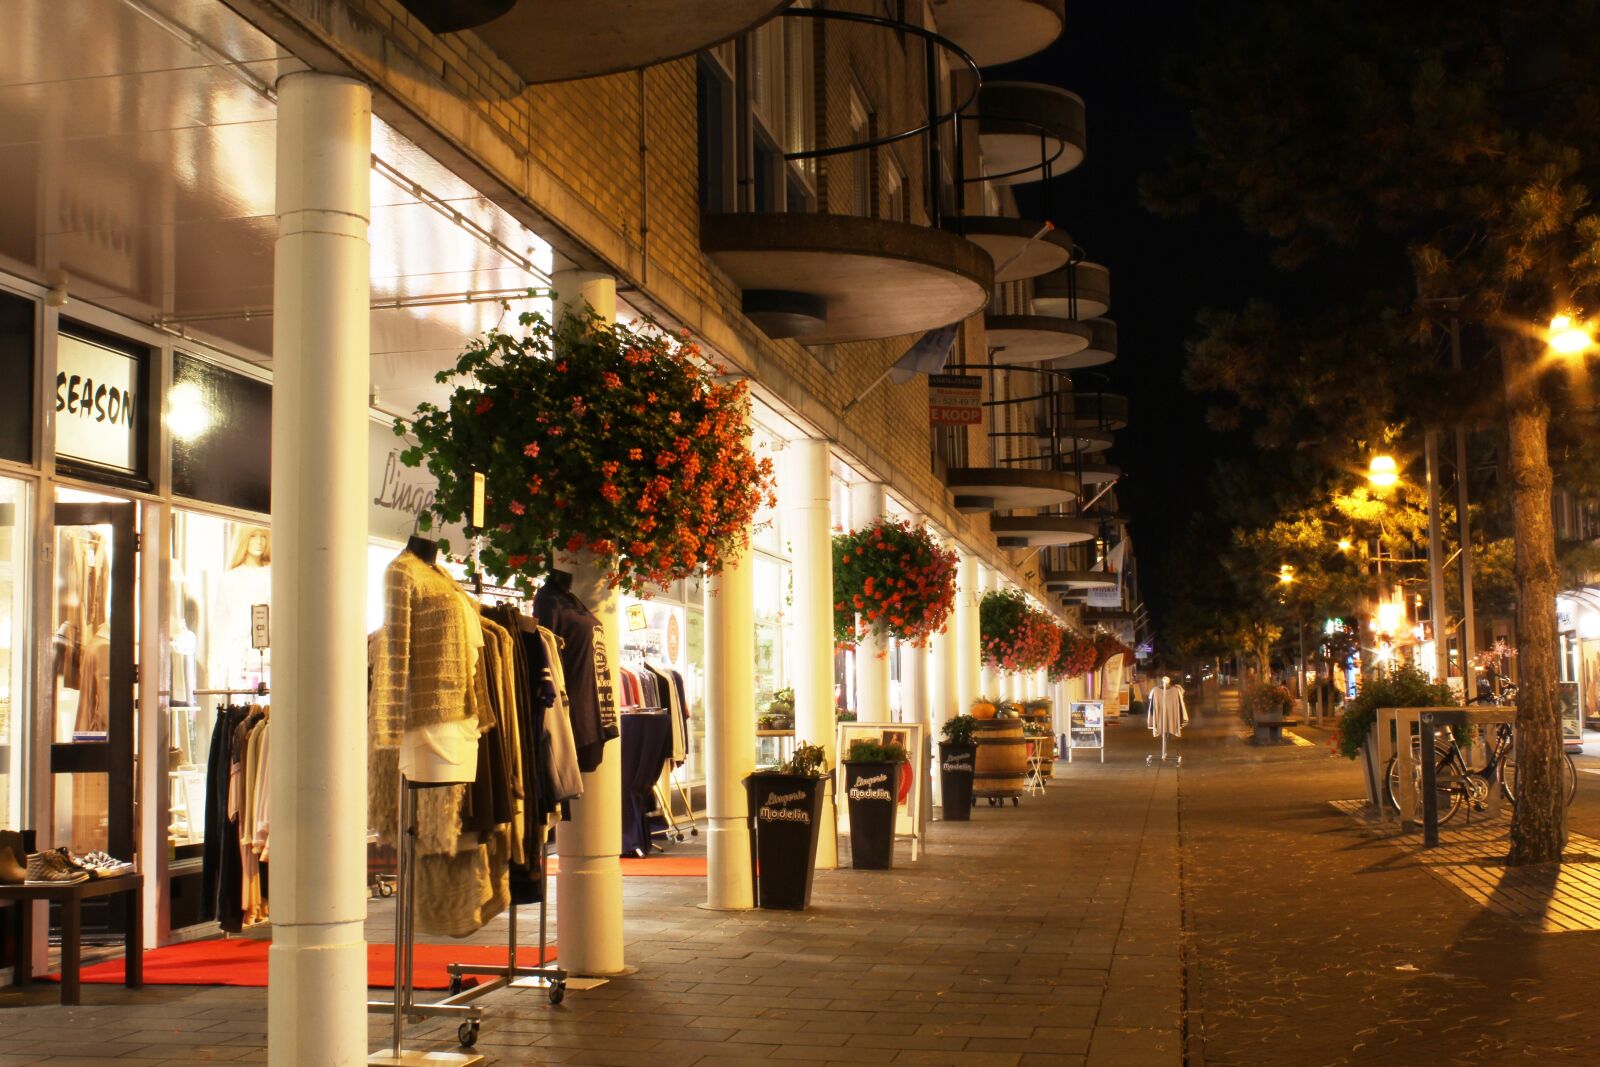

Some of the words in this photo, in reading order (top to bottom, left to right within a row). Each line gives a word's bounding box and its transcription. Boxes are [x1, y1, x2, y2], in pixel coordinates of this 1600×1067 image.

[56, 371, 137, 430] SEASON
[942, 408, 980, 421] KOOP
[850, 788, 892, 801] Modelin
[760, 806, 811, 825] Modelin
